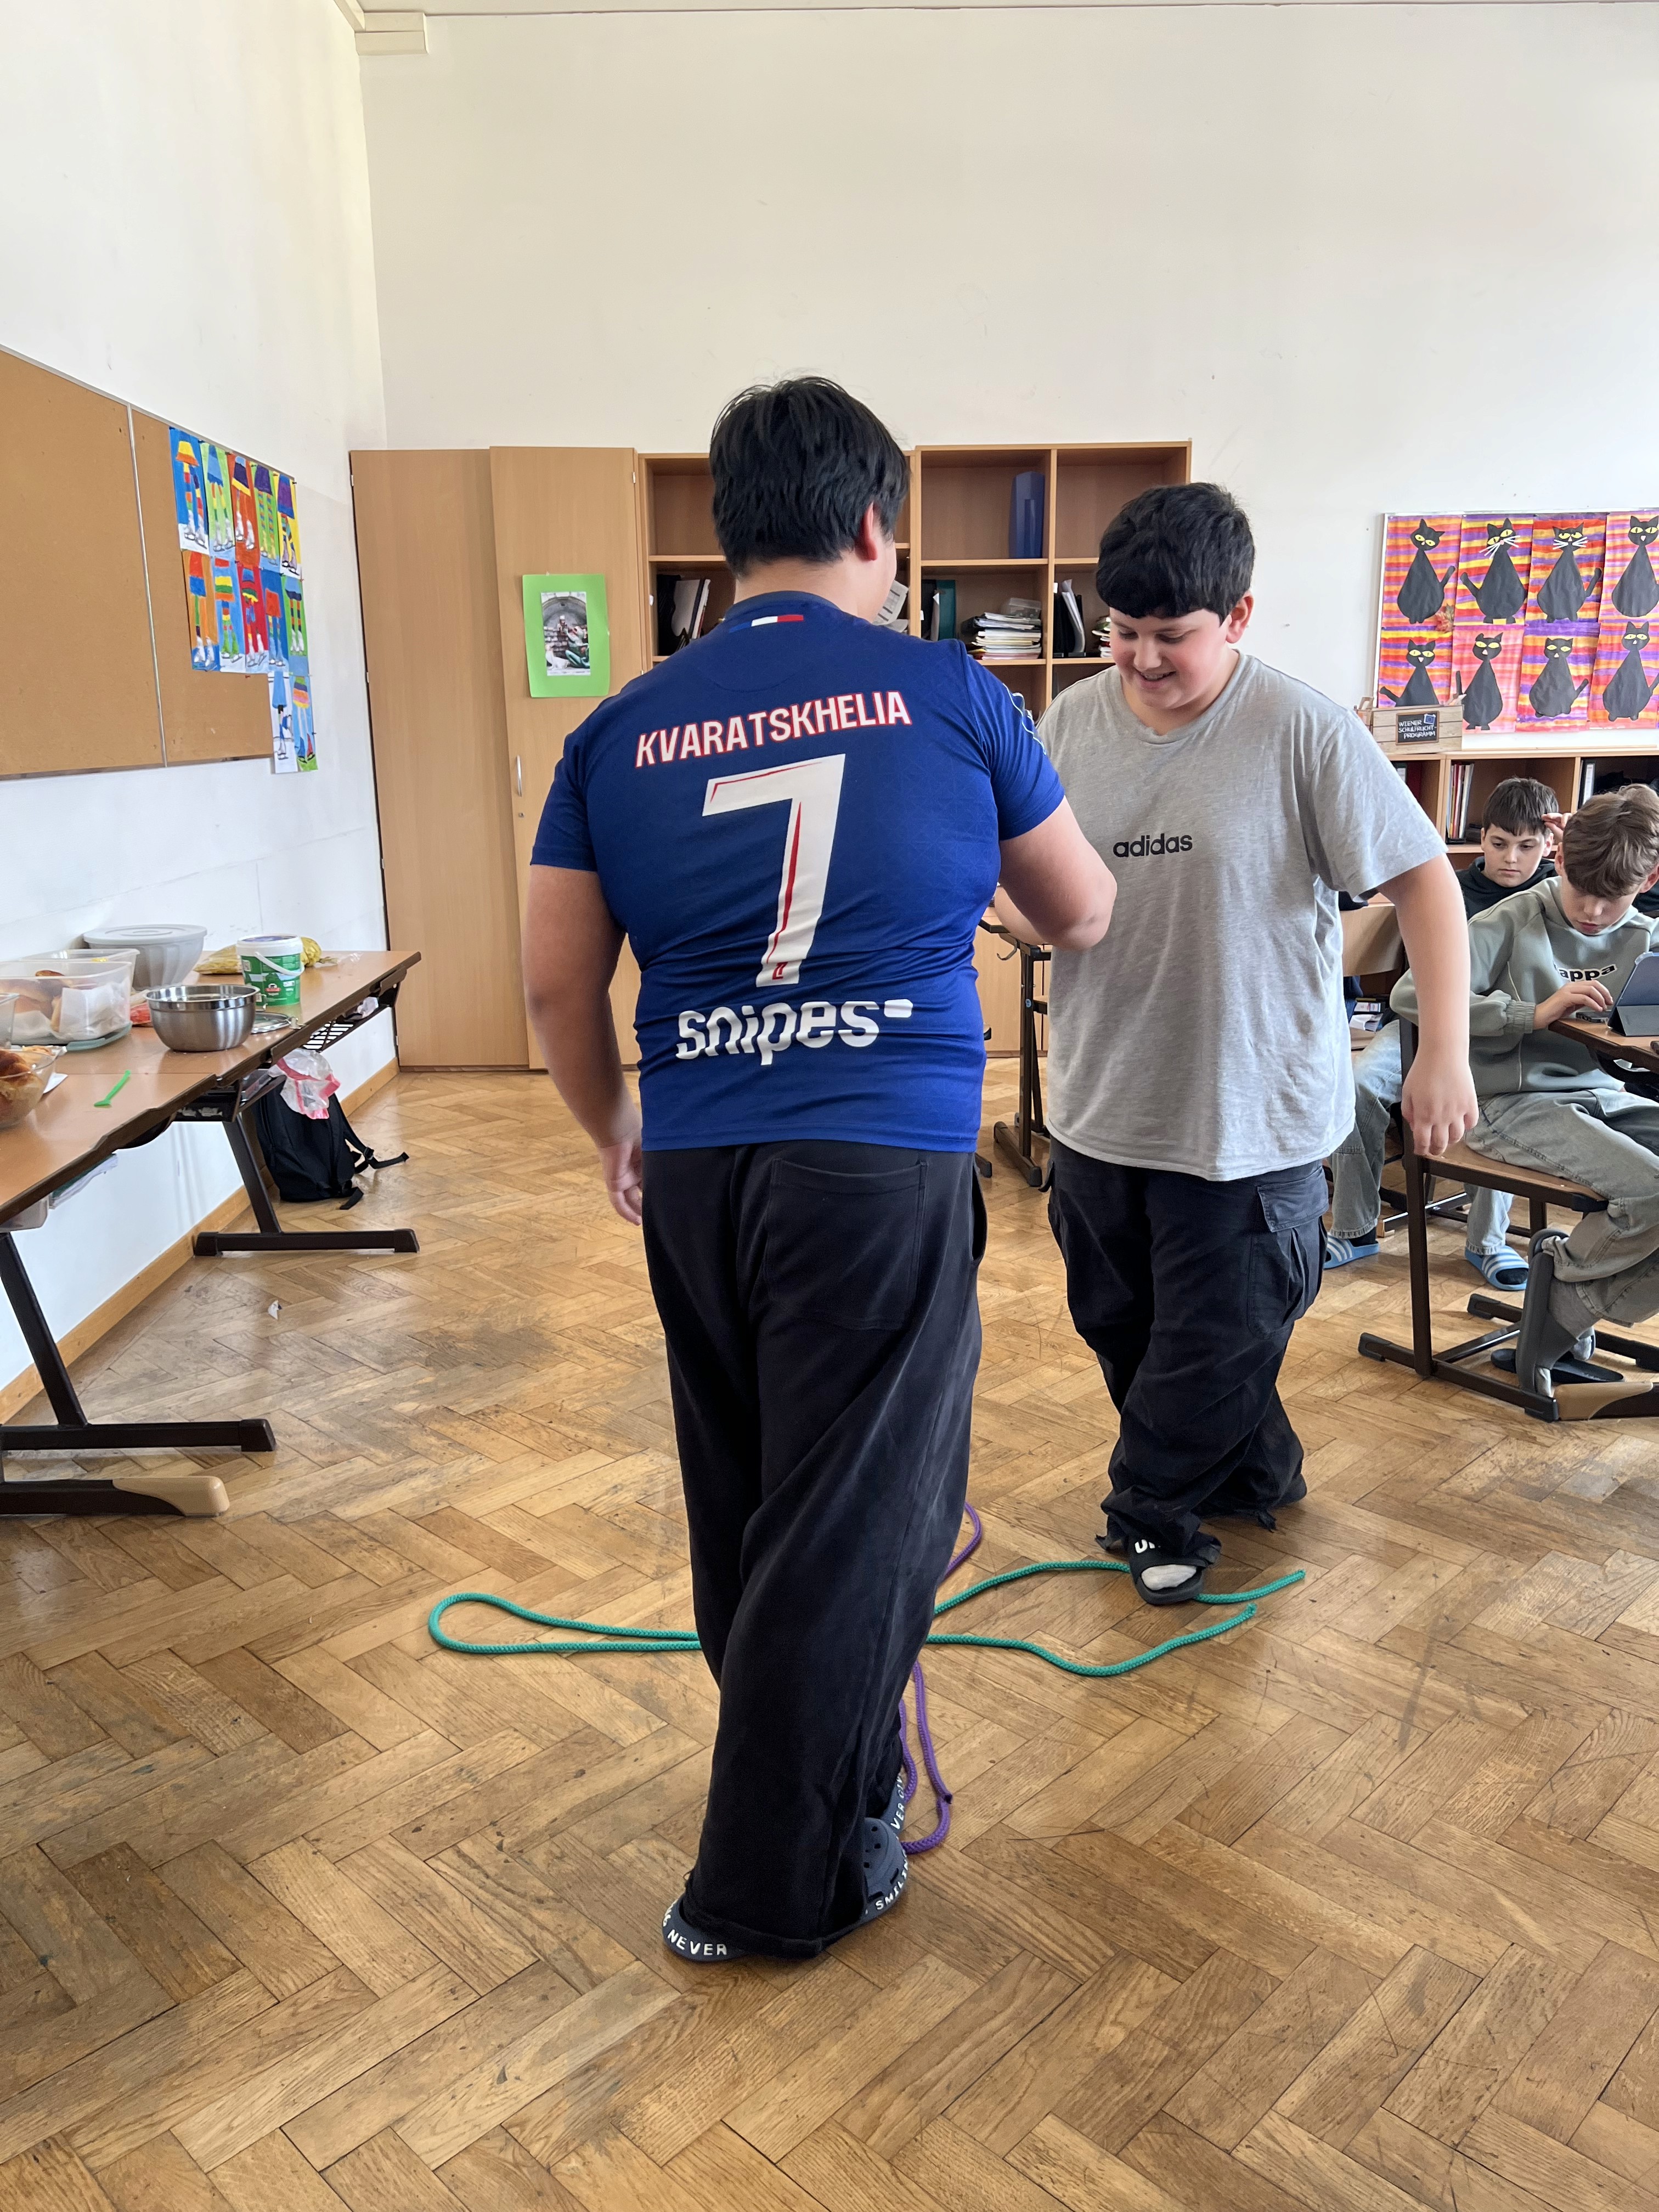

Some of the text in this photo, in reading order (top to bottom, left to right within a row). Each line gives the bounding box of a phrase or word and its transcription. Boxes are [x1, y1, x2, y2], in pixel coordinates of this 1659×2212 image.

[635, 691, 912, 768] KVARATSKHELIA
[1403, 731, 1436, 740] PROGRAMM
[1113, 833, 1193, 857] adidas
[702, 754, 845, 987] 7
[1553, 963, 1615, 982] appa
[675, 1000, 879, 1065] snipes
[667, 1929, 727, 1956] NEVER
